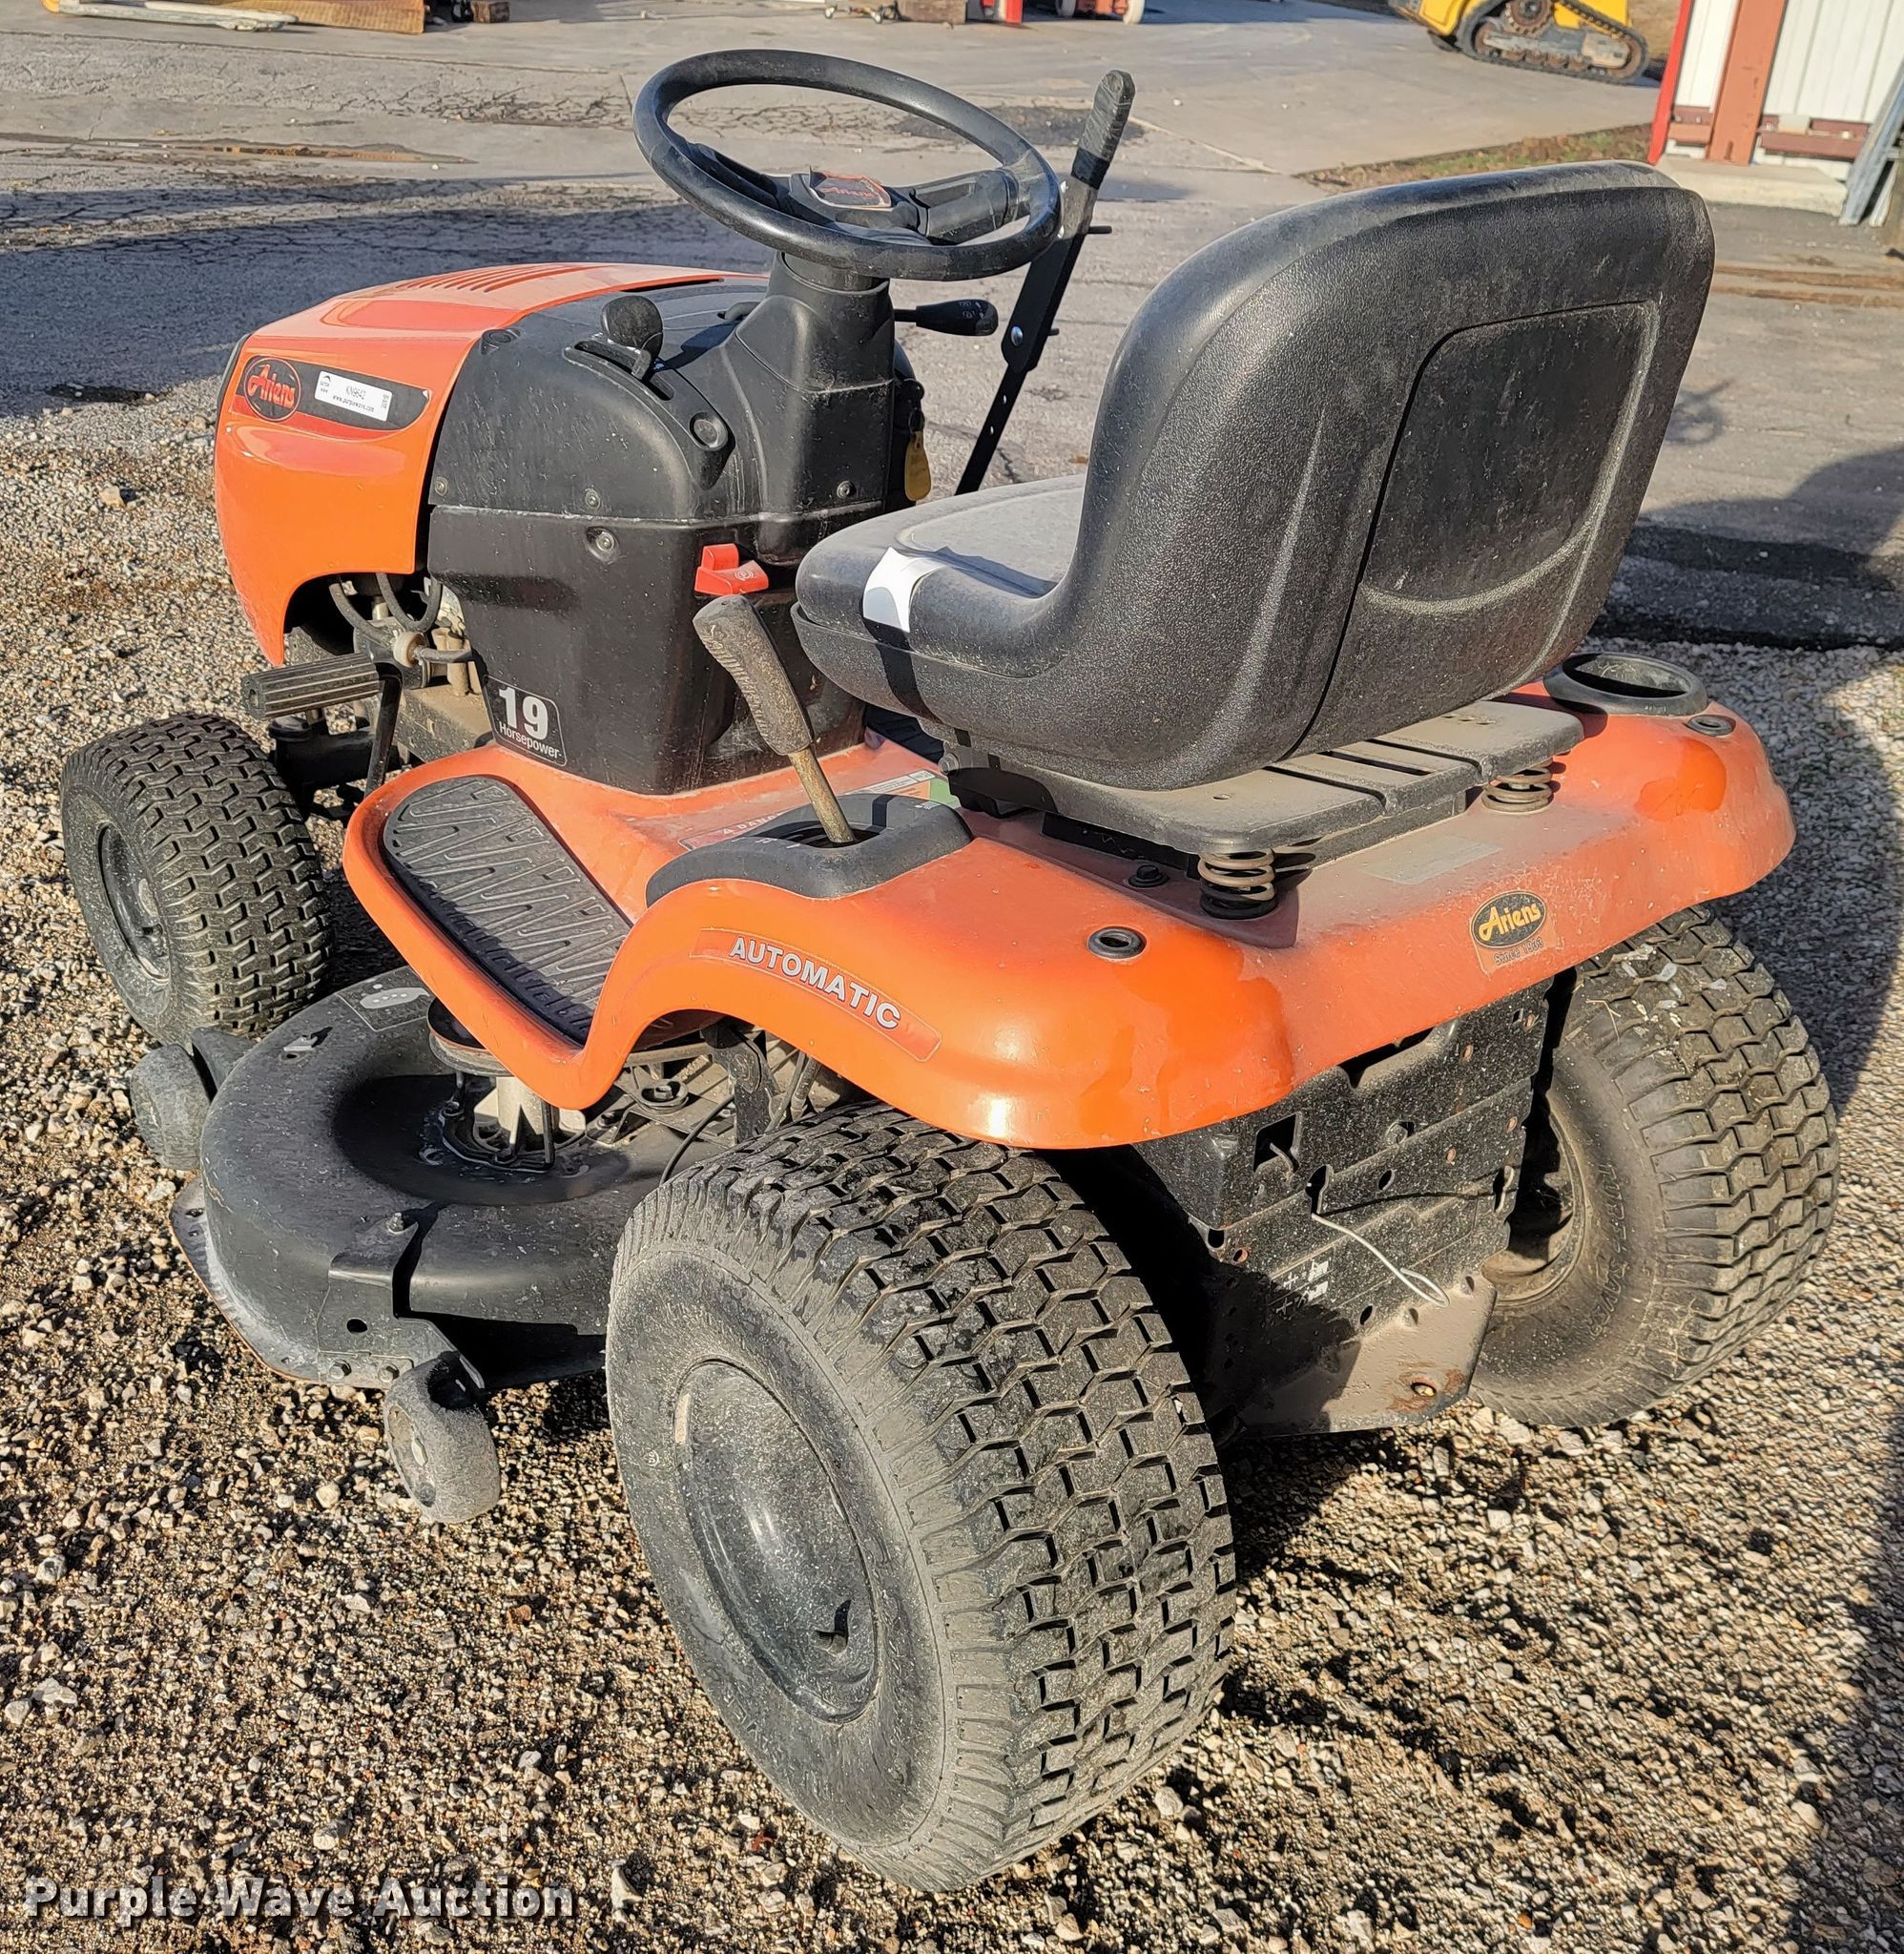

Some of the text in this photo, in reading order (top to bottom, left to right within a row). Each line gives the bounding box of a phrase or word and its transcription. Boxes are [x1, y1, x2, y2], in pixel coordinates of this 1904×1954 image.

[248, 364, 296, 408] Ariens
[499, 687, 548, 740] 19
[1479, 903, 1542, 941] Ariens
[729, 937, 901, 1030] AUTOMATIC
